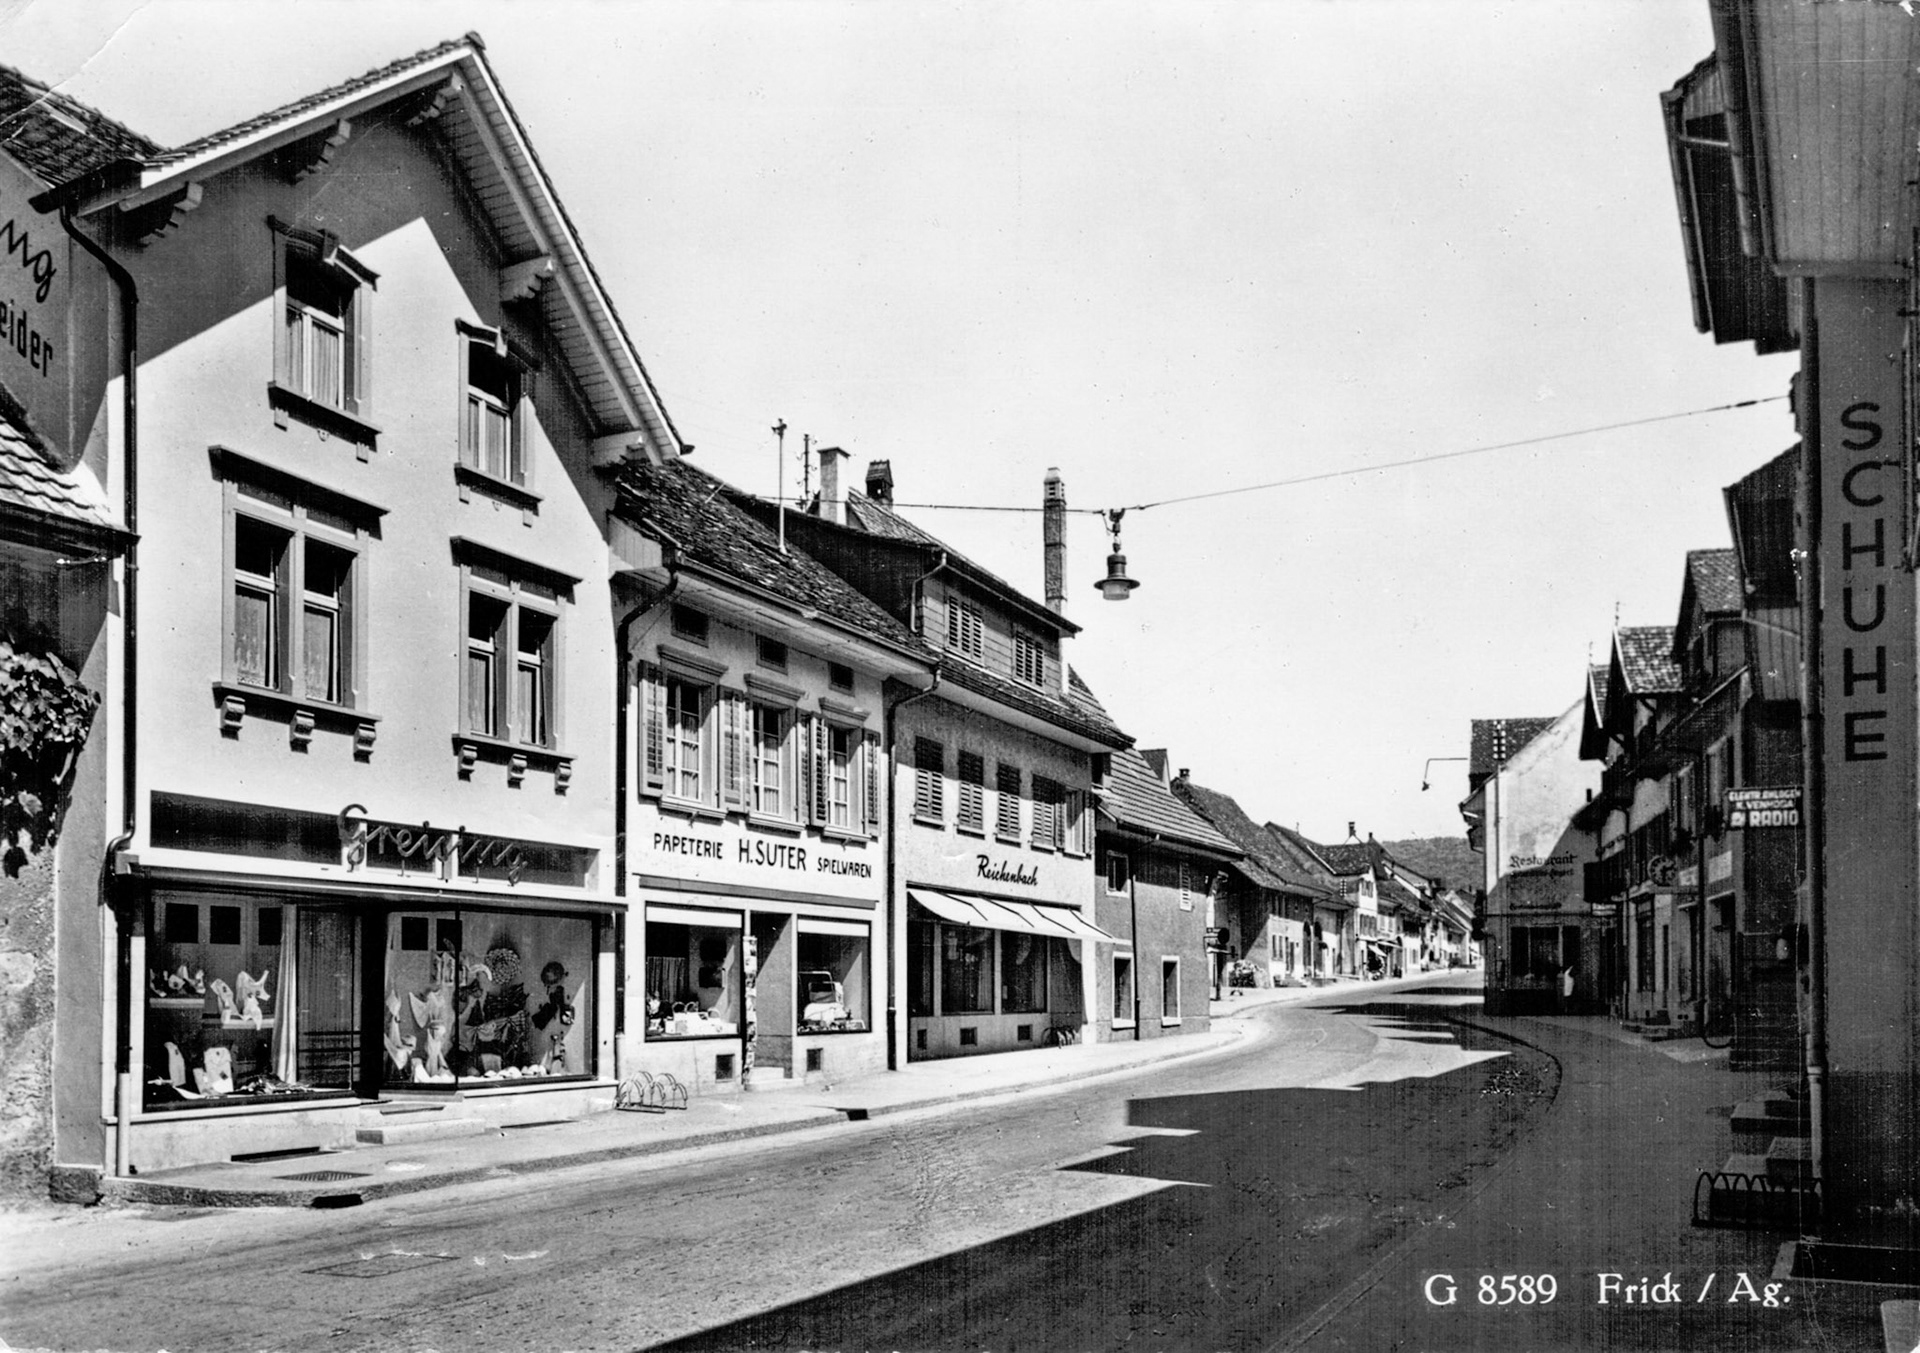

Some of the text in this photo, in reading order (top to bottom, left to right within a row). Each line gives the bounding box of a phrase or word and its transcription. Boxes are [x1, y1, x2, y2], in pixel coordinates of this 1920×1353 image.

[1840, 402, 1888, 762] SCHUHE
[1749, 809, 1799, 827] RADIO
[653, 832, 724, 860] PAPETERIE
[817, 857, 872, 879] SPIELWAREN
[976, 854, 1039, 886] Reichenbach
